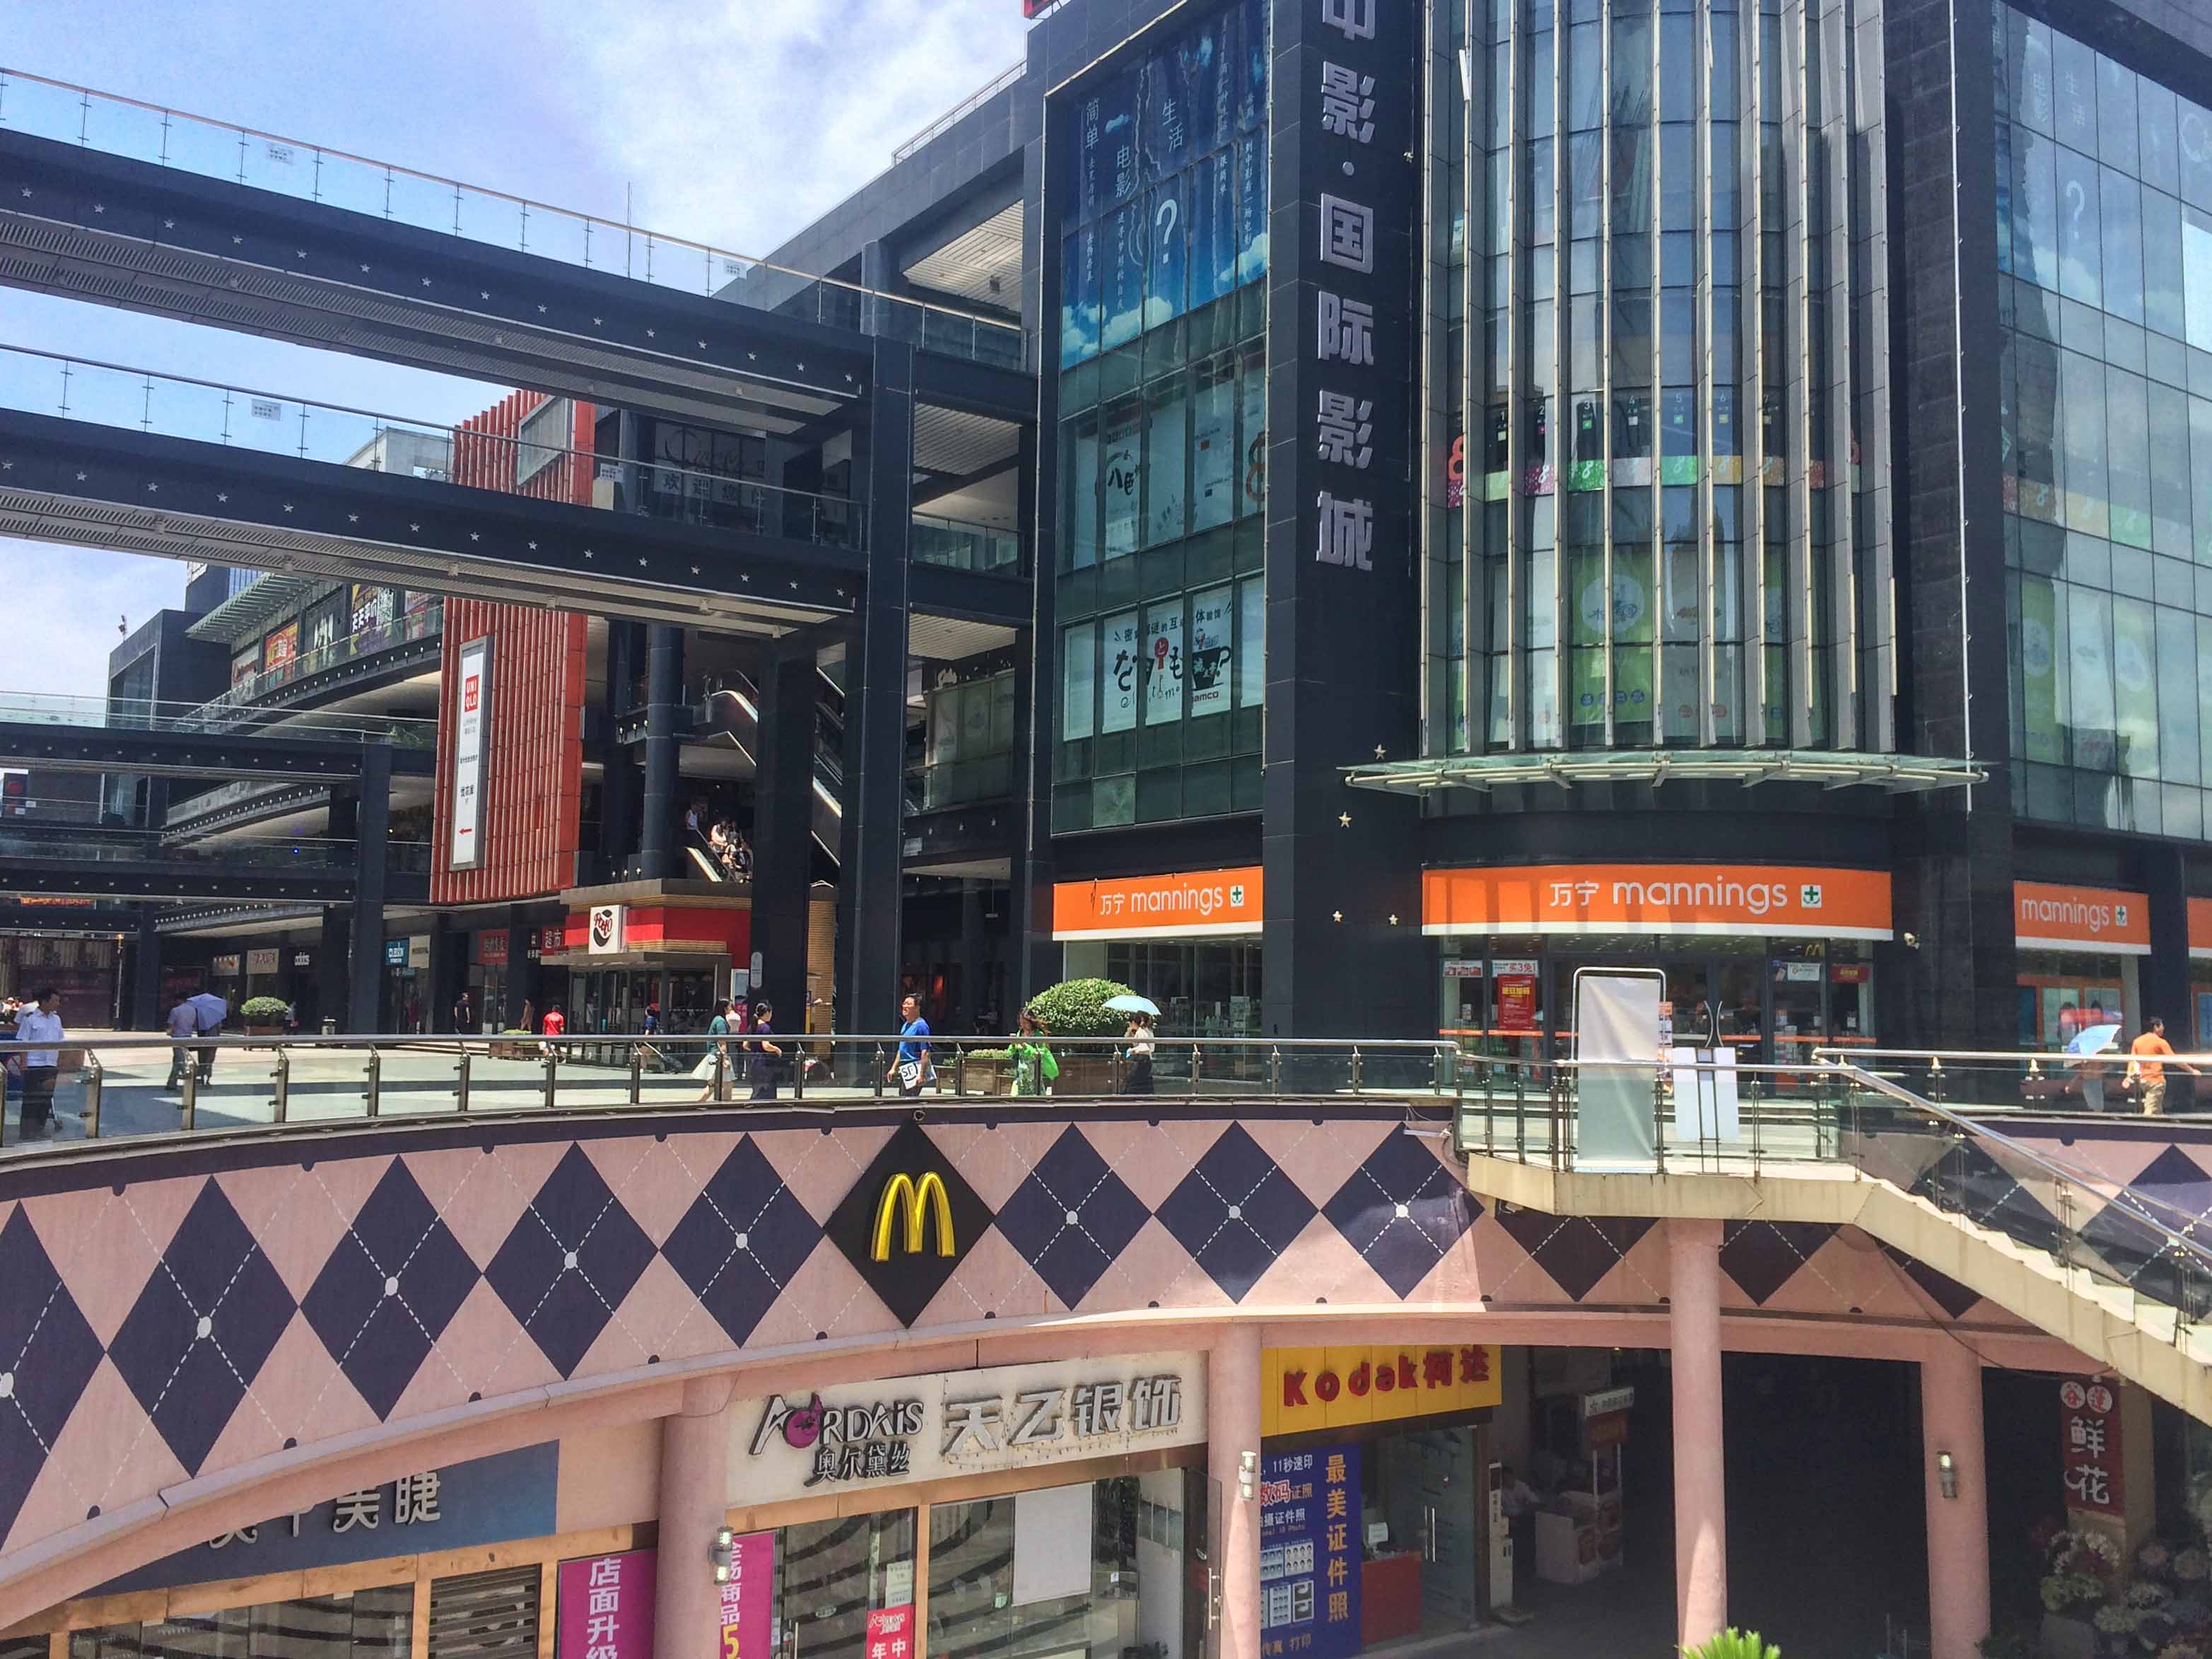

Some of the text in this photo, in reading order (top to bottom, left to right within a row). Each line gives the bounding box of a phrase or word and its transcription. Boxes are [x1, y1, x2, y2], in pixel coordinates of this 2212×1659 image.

[1084, 97, 1099, 151] 简单
[1162, 98, 1183, 153] 生活
[1116, 144, 1131, 198] 电影
[1100, 883, 1223, 915] 万宁 mannings
[1550, 875, 1788, 914] 万宁 mannings
[2022, 896, 2110, 932] mannings
[1283, 1356, 1418, 1407] Kodak
[2064, 1414, 2110, 1505] 鲜花
[1325, 1454, 1349, 1623] 最美证件照
[872, 1638, 906, 1659] 年中
